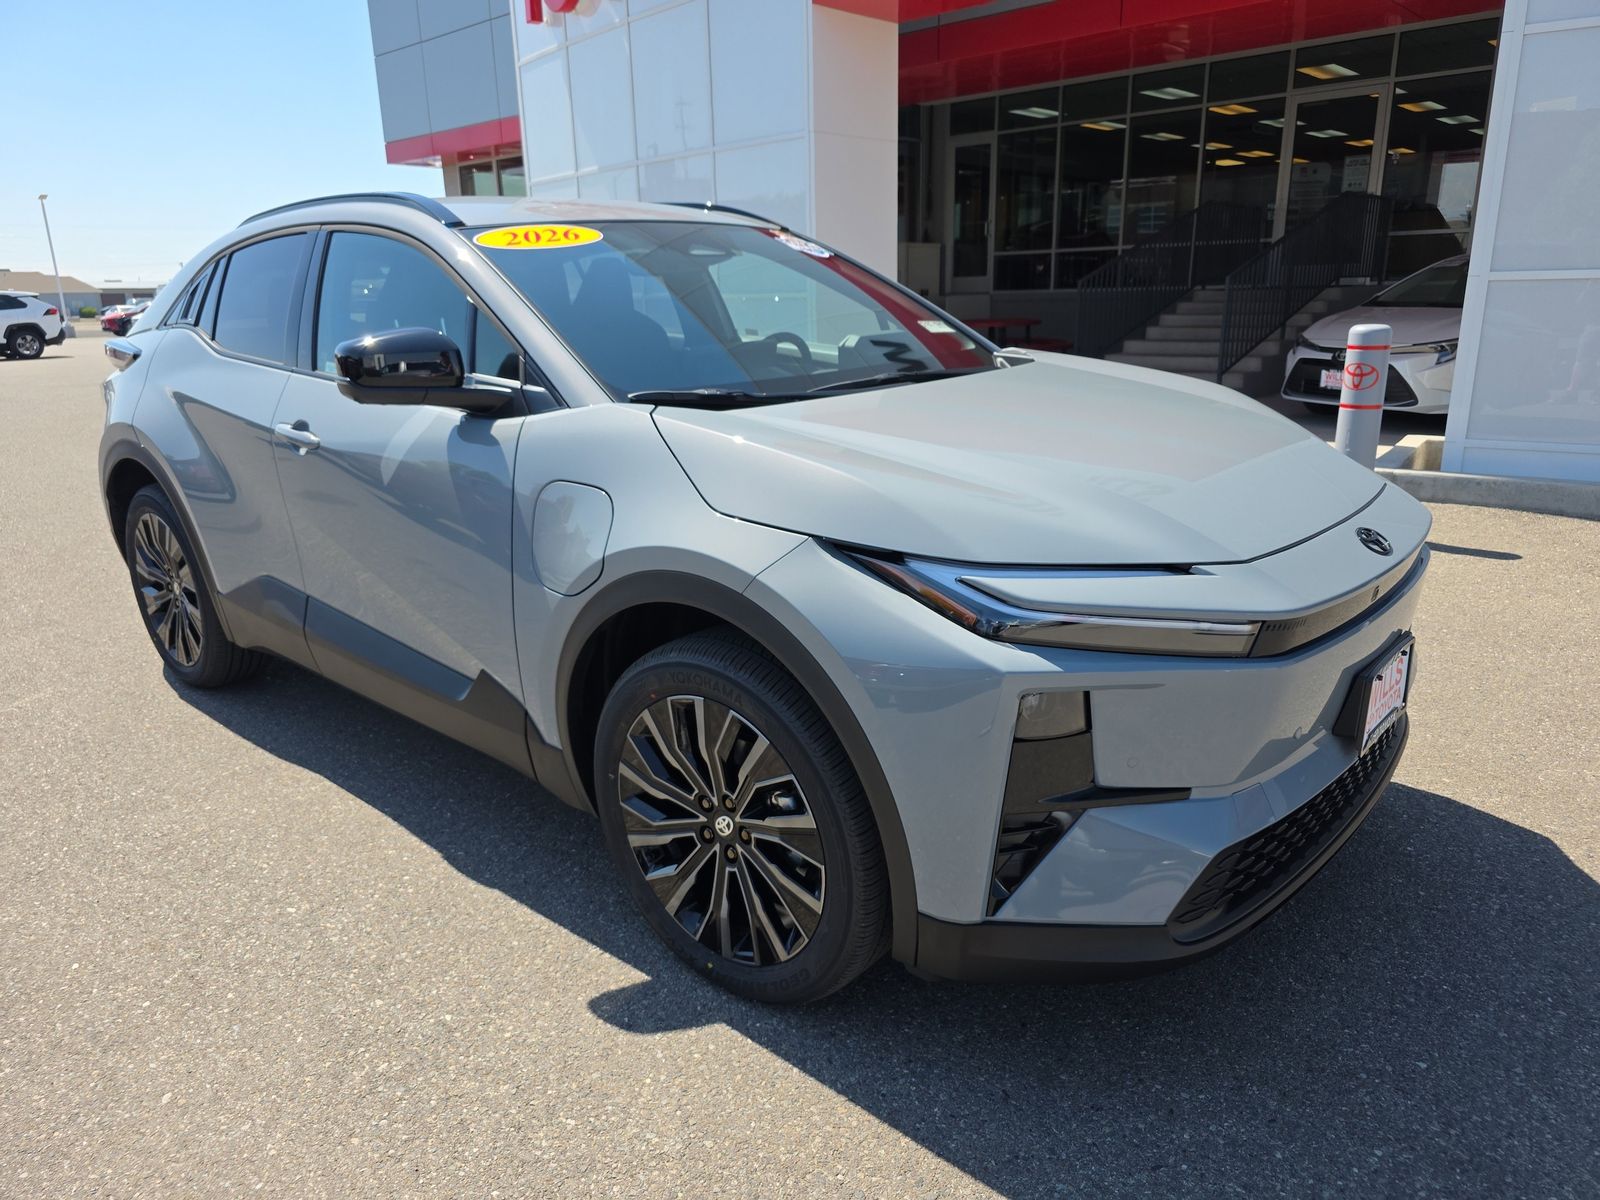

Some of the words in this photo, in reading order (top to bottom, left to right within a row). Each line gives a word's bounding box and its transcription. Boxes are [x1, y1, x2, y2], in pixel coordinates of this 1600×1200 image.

[503, 229, 580, 246] 2026
[668, 671, 744, 707] YOKOHAMA
[1373, 687, 1402, 722] TOYOTA
